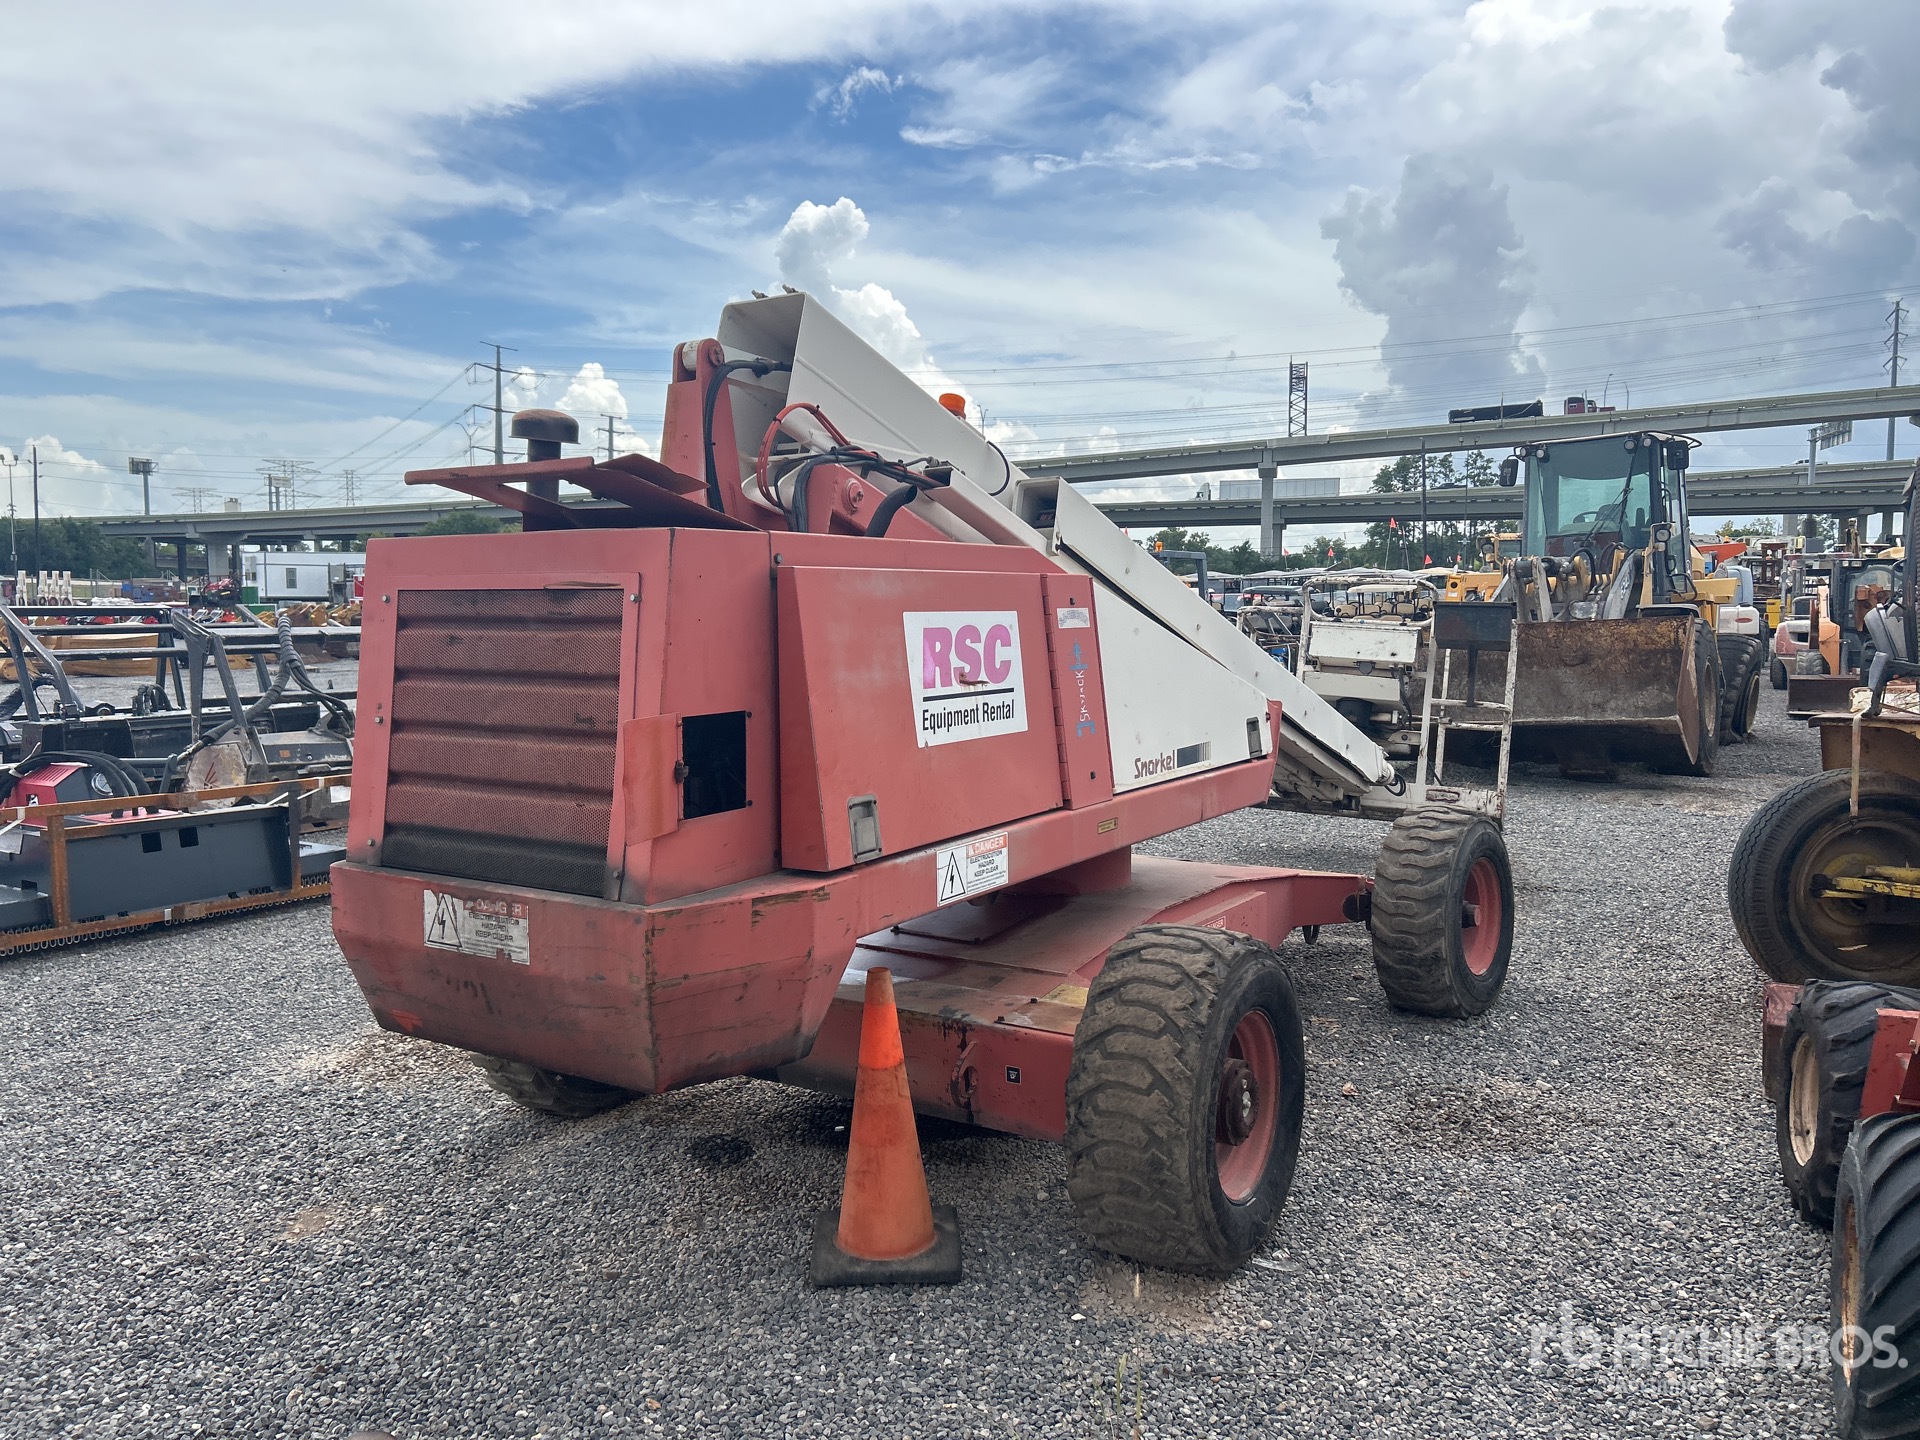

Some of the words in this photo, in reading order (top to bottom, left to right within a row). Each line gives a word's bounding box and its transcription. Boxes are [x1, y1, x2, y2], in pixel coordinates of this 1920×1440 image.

[922, 623, 1012, 690] RSC
[922, 703, 979, 734] Equipment
[983, 699, 1015, 723] Rental
[1134, 749, 1175, 779] Snorkel
[976, 837, 1004, 852] DANGER
[970, 849, 1003, 865] ELECTROCUTION
[978, 858, 995, 869] HAZARD
[975, 869, 985, 877] KEEP
[986, 865, 999, 874] CLEAR
